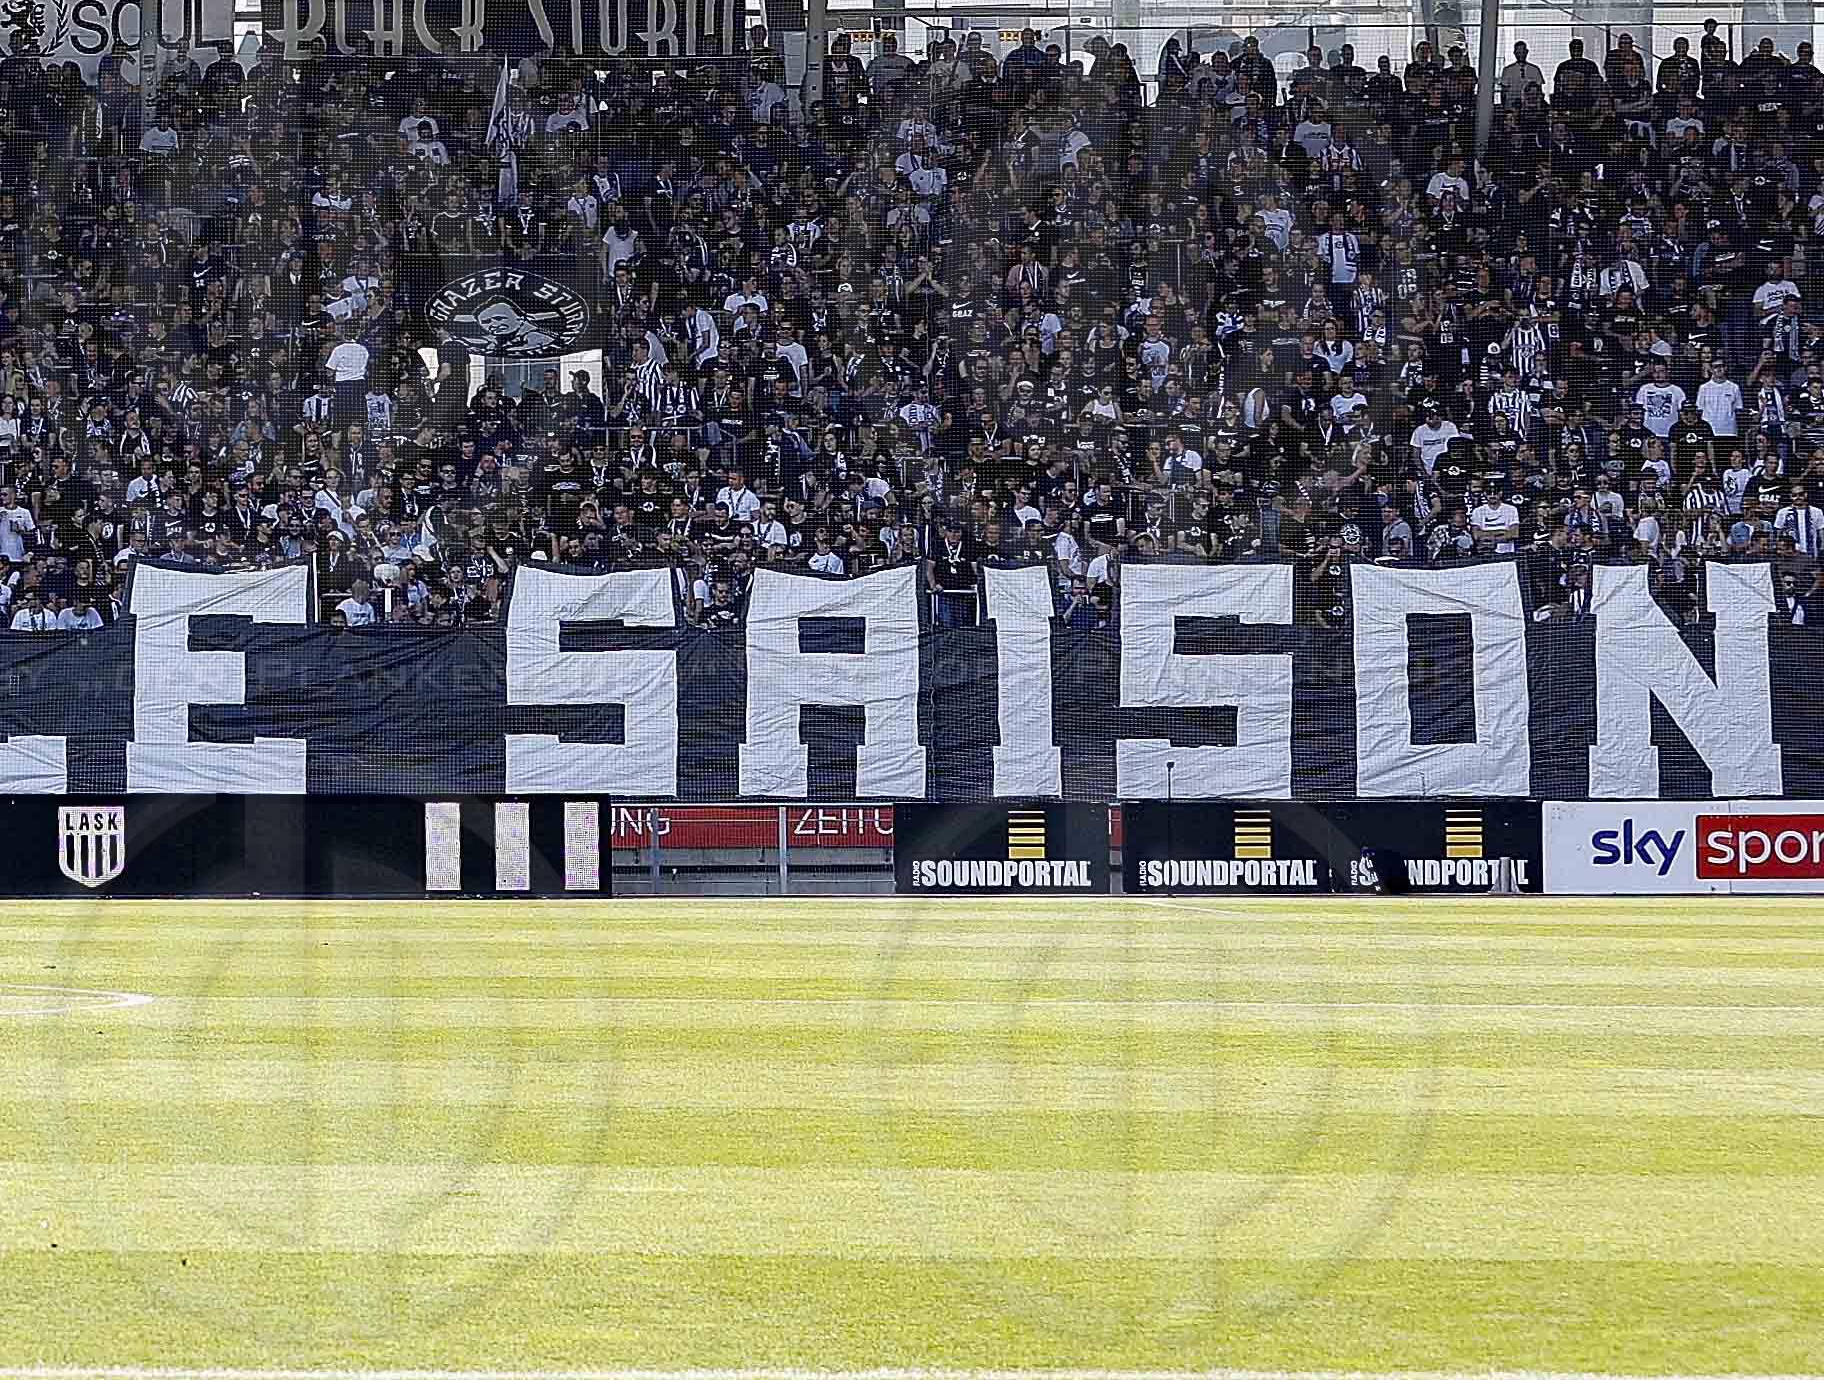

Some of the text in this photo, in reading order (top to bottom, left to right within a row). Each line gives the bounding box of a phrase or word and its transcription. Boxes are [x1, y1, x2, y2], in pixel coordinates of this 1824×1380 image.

[428, 270, 525, 322] GRAZER
[503, 560, 1784, 800] SAISON
[64, 811, 119, 831] LASK
[1592, 818, 1687, 878] sky
[920, 859, 1092, 888] SOUNDPORTAL
[1147, 858, 1319, 887] SOUNDPORTAL
